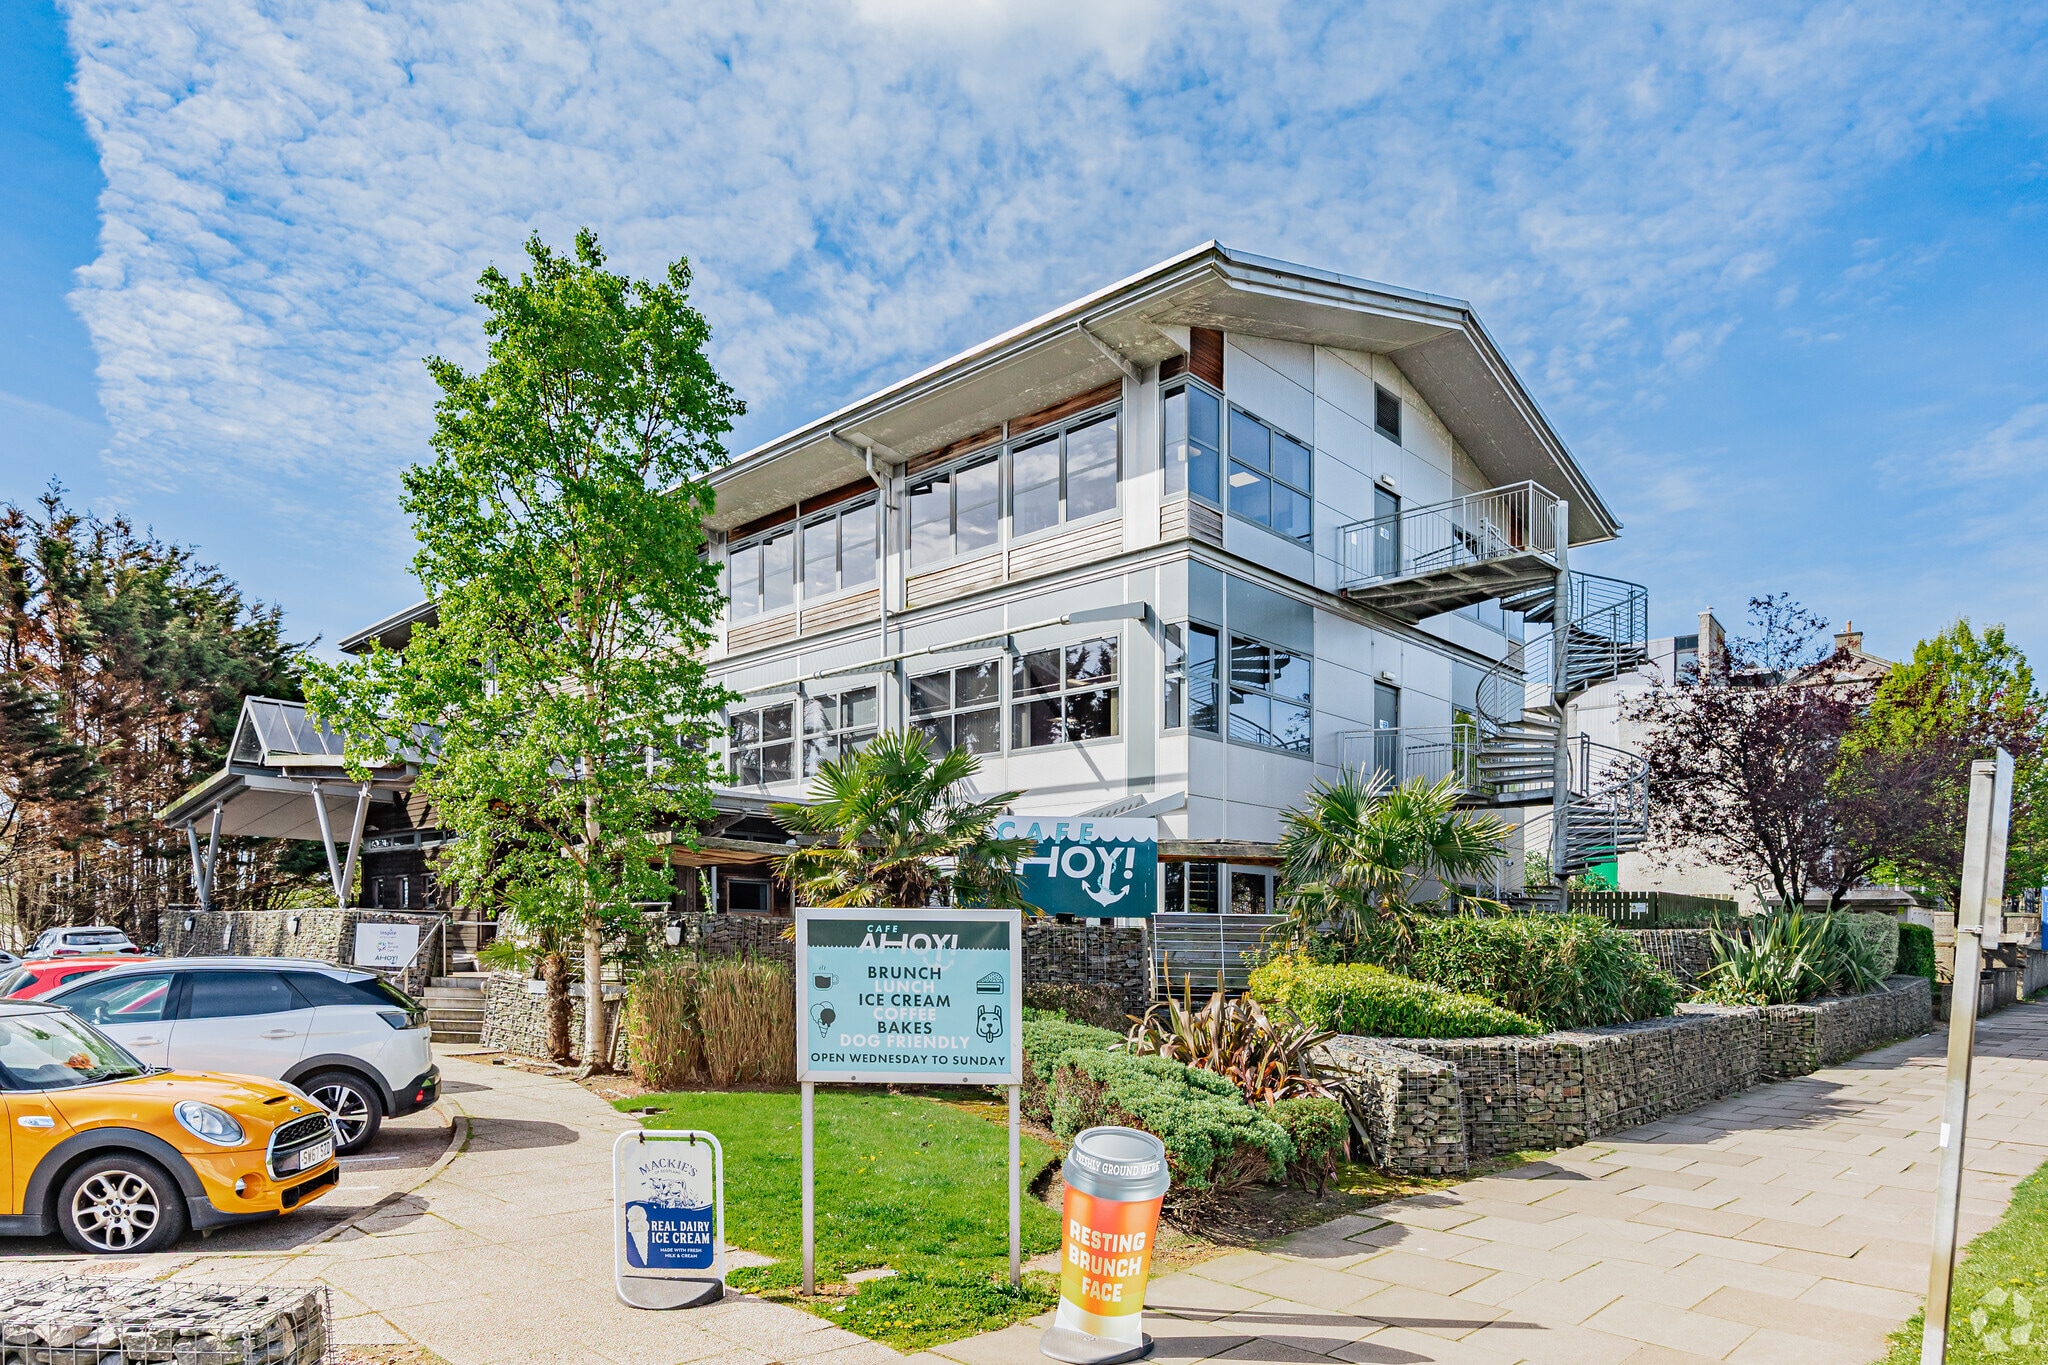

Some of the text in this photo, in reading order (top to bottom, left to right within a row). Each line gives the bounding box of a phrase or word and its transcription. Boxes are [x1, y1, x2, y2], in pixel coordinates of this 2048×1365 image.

[997, 821, 1094, 845] CAFE
[990, 846, 1136, 888] HOY!
[866, 925, 899, 933] CAFE
[857, 933, 959, 960] AHOY!
[867, 966, 942, 980] BRUNCH
[874, 980, 935, 994] LUNCH
[858, 993, 951, 1008] ICE CREAM
[873, 1007, 937, 1021] COFFEE
[877, 1021, 933, 1034] BAKES
[840, 1034, 971, 1049] DOG FRIENDLY
[810, 1052, 1006, 1066] OPEN WEDNESDAY TO SUNDAY
[639, 1158, 698, 1176] MACKIE'S
[1076, 1150, 1161, 1177] FRESHLY GROUND HERE
[651, 1220, 710, 1232] REAL DAIRY
[651, 1232, 710, 1244] ICE CREAM
[1069, 1218, 1147, 1253] RESTING
[1068, 1242, 1143, 1278] BRUNCH
[1081, 1275, 1123, 1303] FACE
